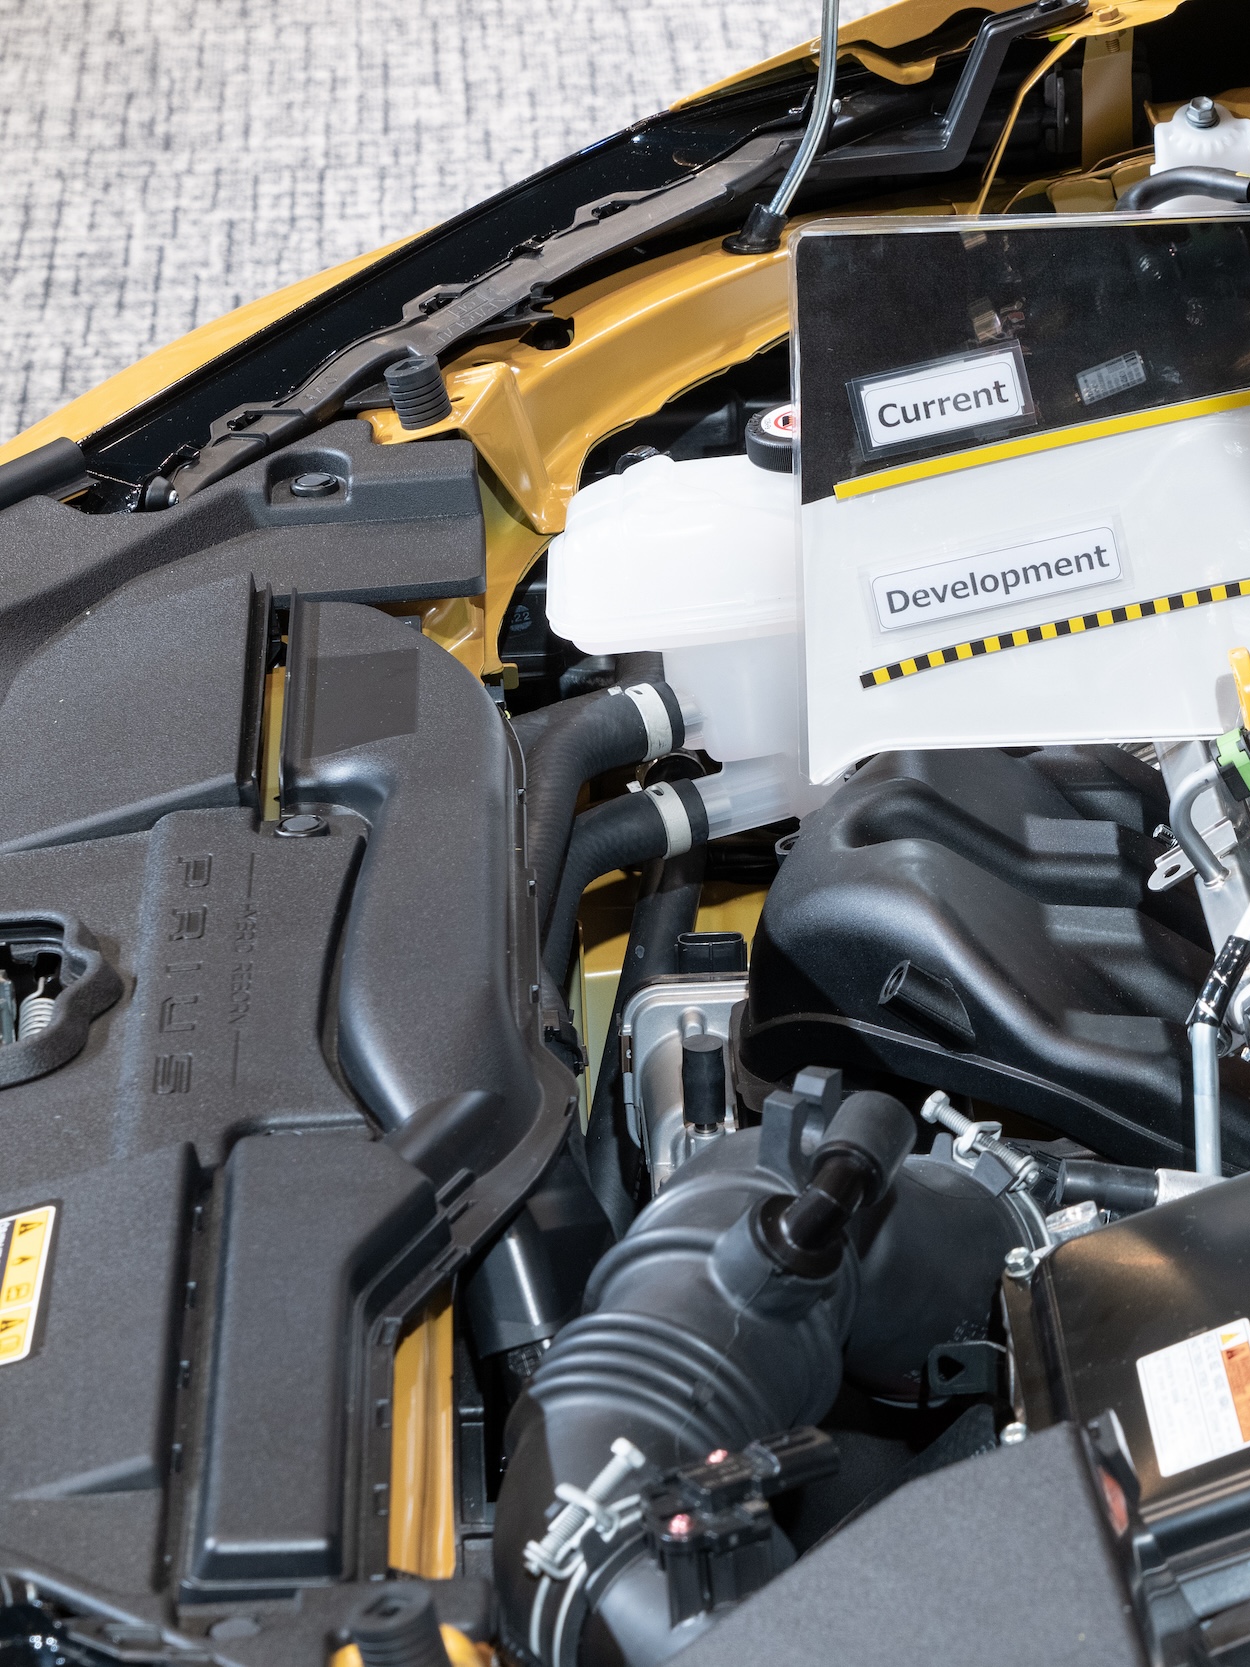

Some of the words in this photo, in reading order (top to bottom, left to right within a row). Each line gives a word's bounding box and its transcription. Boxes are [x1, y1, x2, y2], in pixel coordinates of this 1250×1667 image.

[878, 380, 1009, 427] Current
[886, 545, 1110, 613] Development
[153, 853, 213, 1095] PRIUS
